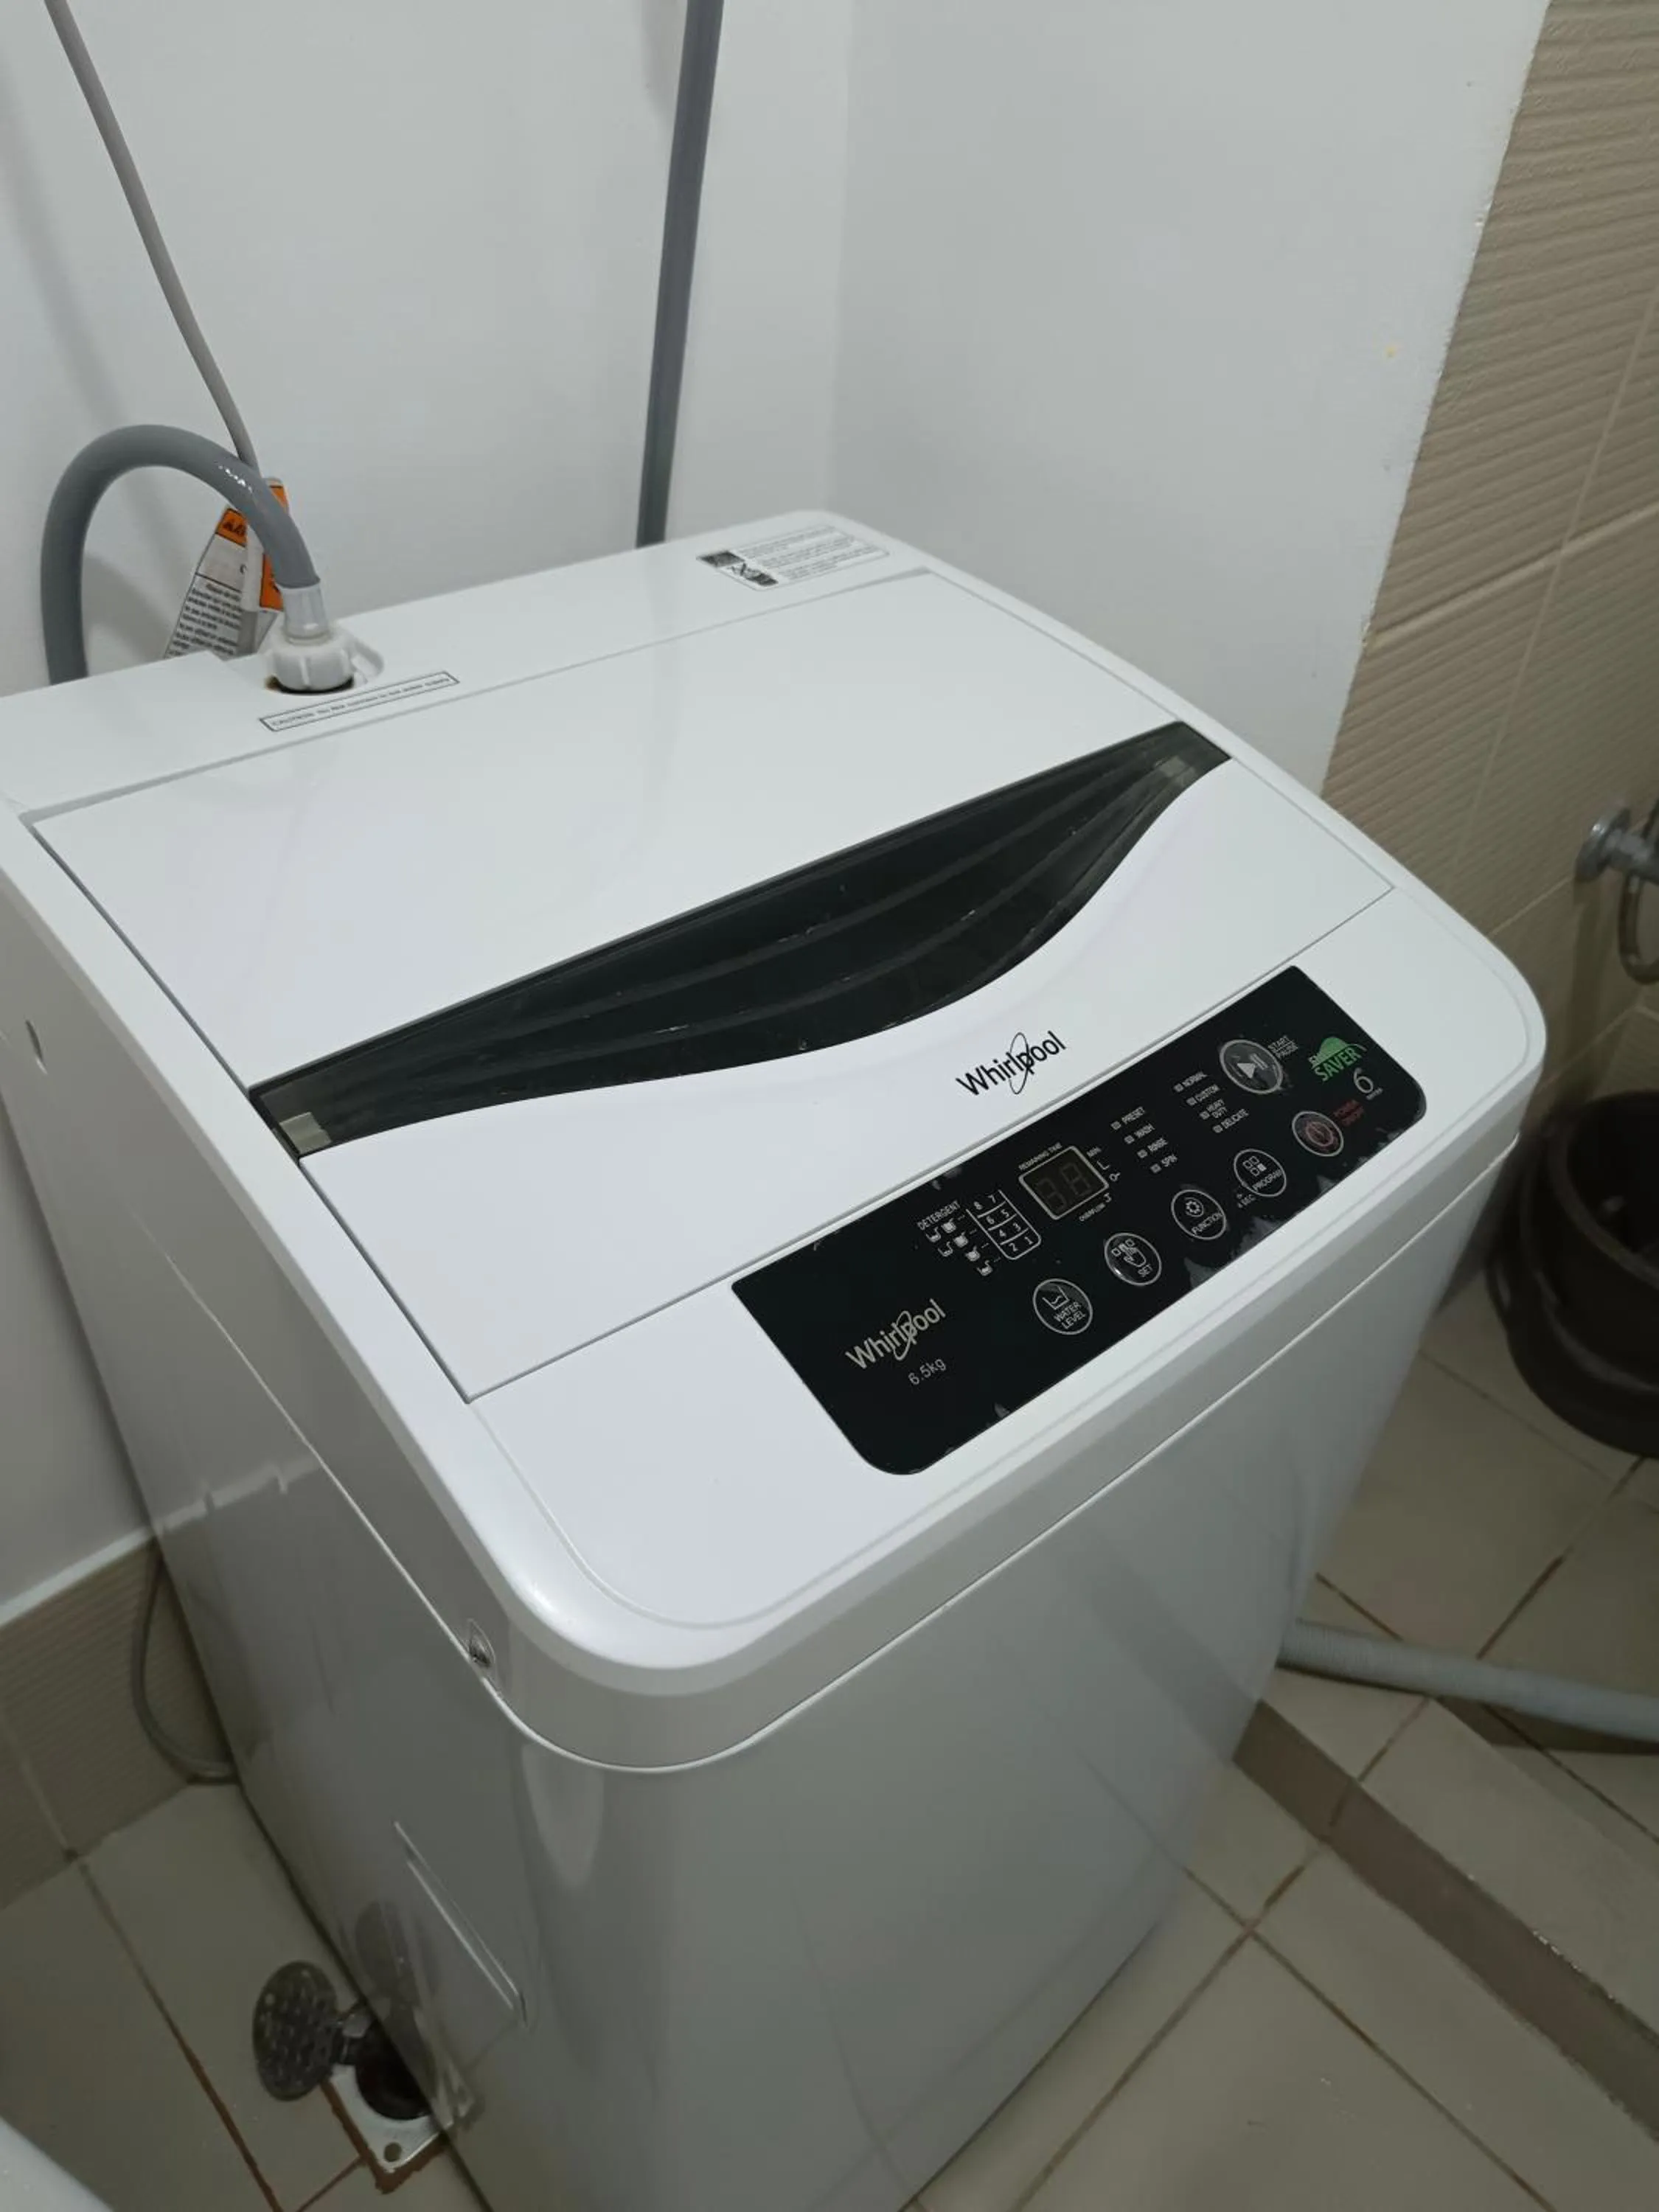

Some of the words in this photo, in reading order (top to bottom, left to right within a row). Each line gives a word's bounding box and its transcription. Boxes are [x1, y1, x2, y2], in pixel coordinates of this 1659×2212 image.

[1267, 1035, 1290, 1051] START
[1276, 1040, 1298, 1059] PAUSE
[956, 1030, 1066, 1095] Whirlpool
[1313, 1047, 1361, 1082] SAVER
[1182, 1071, 1208, 1087] NORMAL
[1353, 1068, 1374, 1093] 6
[1194, 1084, 1220, 1102] CUSTOM
[1121, 1107, 1145, 1124] PRESET
[1211, 1107, 1228, 1119] DUTY
[1220, 1108, 1249, 1129] DELICATE
[1133, 1124, 1155, 1138] WASH
[1147, 1138, 1168, 1152] RINSE
[1161, 1153, 1178, 1167] SPIN
[1253, 1169, 1283, 1192] PROGRAM
[974, 1201, 983, 1211] 8
[988, 1194, 997, 1204] 7
[917, 1200, 960, 1231] DETERGENT
[987, 1216, 995, 1225] 6
[1001, 1209, 1010, 1218] 5
[1191, 1211, 1224, 1235] FUNCTION
[998, 1229, 1007, 1238] 4
[1012, 1222, 1022, 1232] 3
[1009, 1242, 1018, 1252] 2
[1024, 1237, 1034, 1246] 1
[1138, 1264, 1153, 1278] SET
[1054, 1301, 1082, 1322] WATER
[1061, 1311, 1086, 1329] LEVEL
[845, 1298, 946, 1369] Whirlpool
[908, 1359, 947, 1385] 6.5kg
